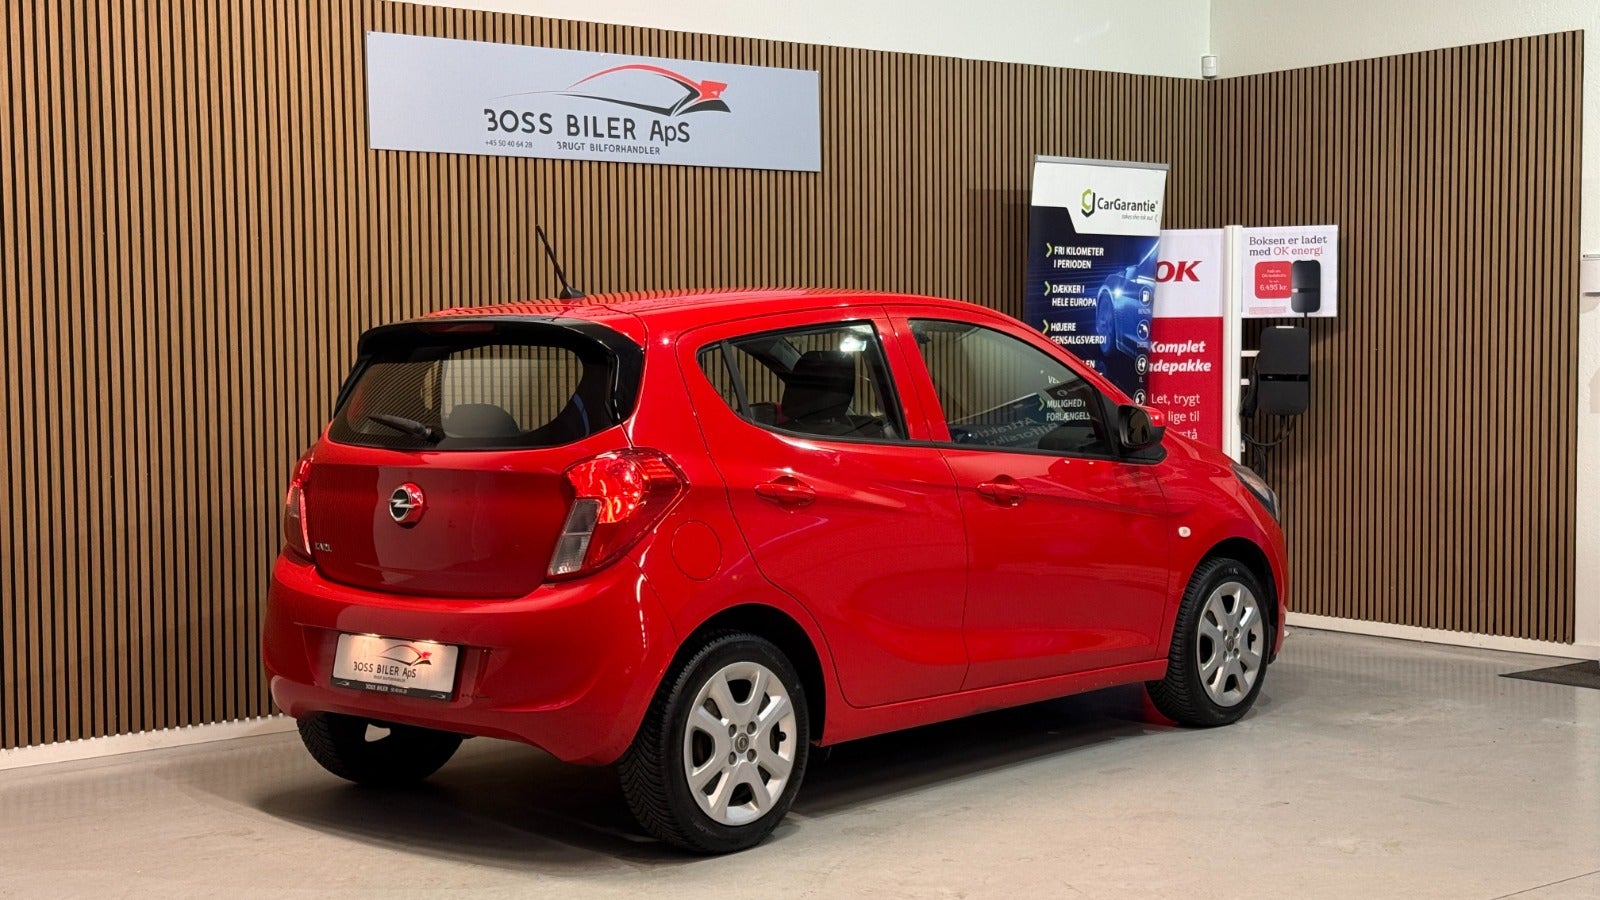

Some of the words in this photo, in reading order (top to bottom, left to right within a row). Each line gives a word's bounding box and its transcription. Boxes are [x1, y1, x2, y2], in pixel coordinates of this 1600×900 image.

[484, 108, 553, 134] BOSS
[566, 114, 636, 140] BILER
[650, 120, 690, 146] ApS
[556, 141, 585, 151] BRUGT
[590, 143, 660, 155] BILFORHANDLER
[1249, 236, 1286, 246] Boksen
[1301, 235, 1328, 244] ladet
[1054, 246, 1065, 255] FRI
[1066, 247, 1104, 256] KILOMETER
[1249, 247, 1271, 256] med
[1273, 246, 1289, 256] OK
[1291, 246, 1323, 256] energi
[1053, 259, 1056, 268] I
[1057, 259, 1091, 269] PERIODEN
[1155, 260, 1203, 283] OK
[1052, 284, 1081, 294] DÆKKER
[1082, 285, 1085, 294] I
[1052, 298, 1069, 307] HELE
[1069, 298, 1097, 307] EUROPA
[1050, 322, 1076, 332] HØJERE
[1150, 339, 1207, 357] Komplet
[1046, 398, 1083, 409] MULIGHED
[1151, 394, 1171, 406] Let,
[1173, 393, 1201, 407] trygt
[1168, 410, 1187, 425] lige
[1189, 410, 1200, 422] til
[376, 664, 399, 677] BILER
[402, 667, 417, 679] ApS
